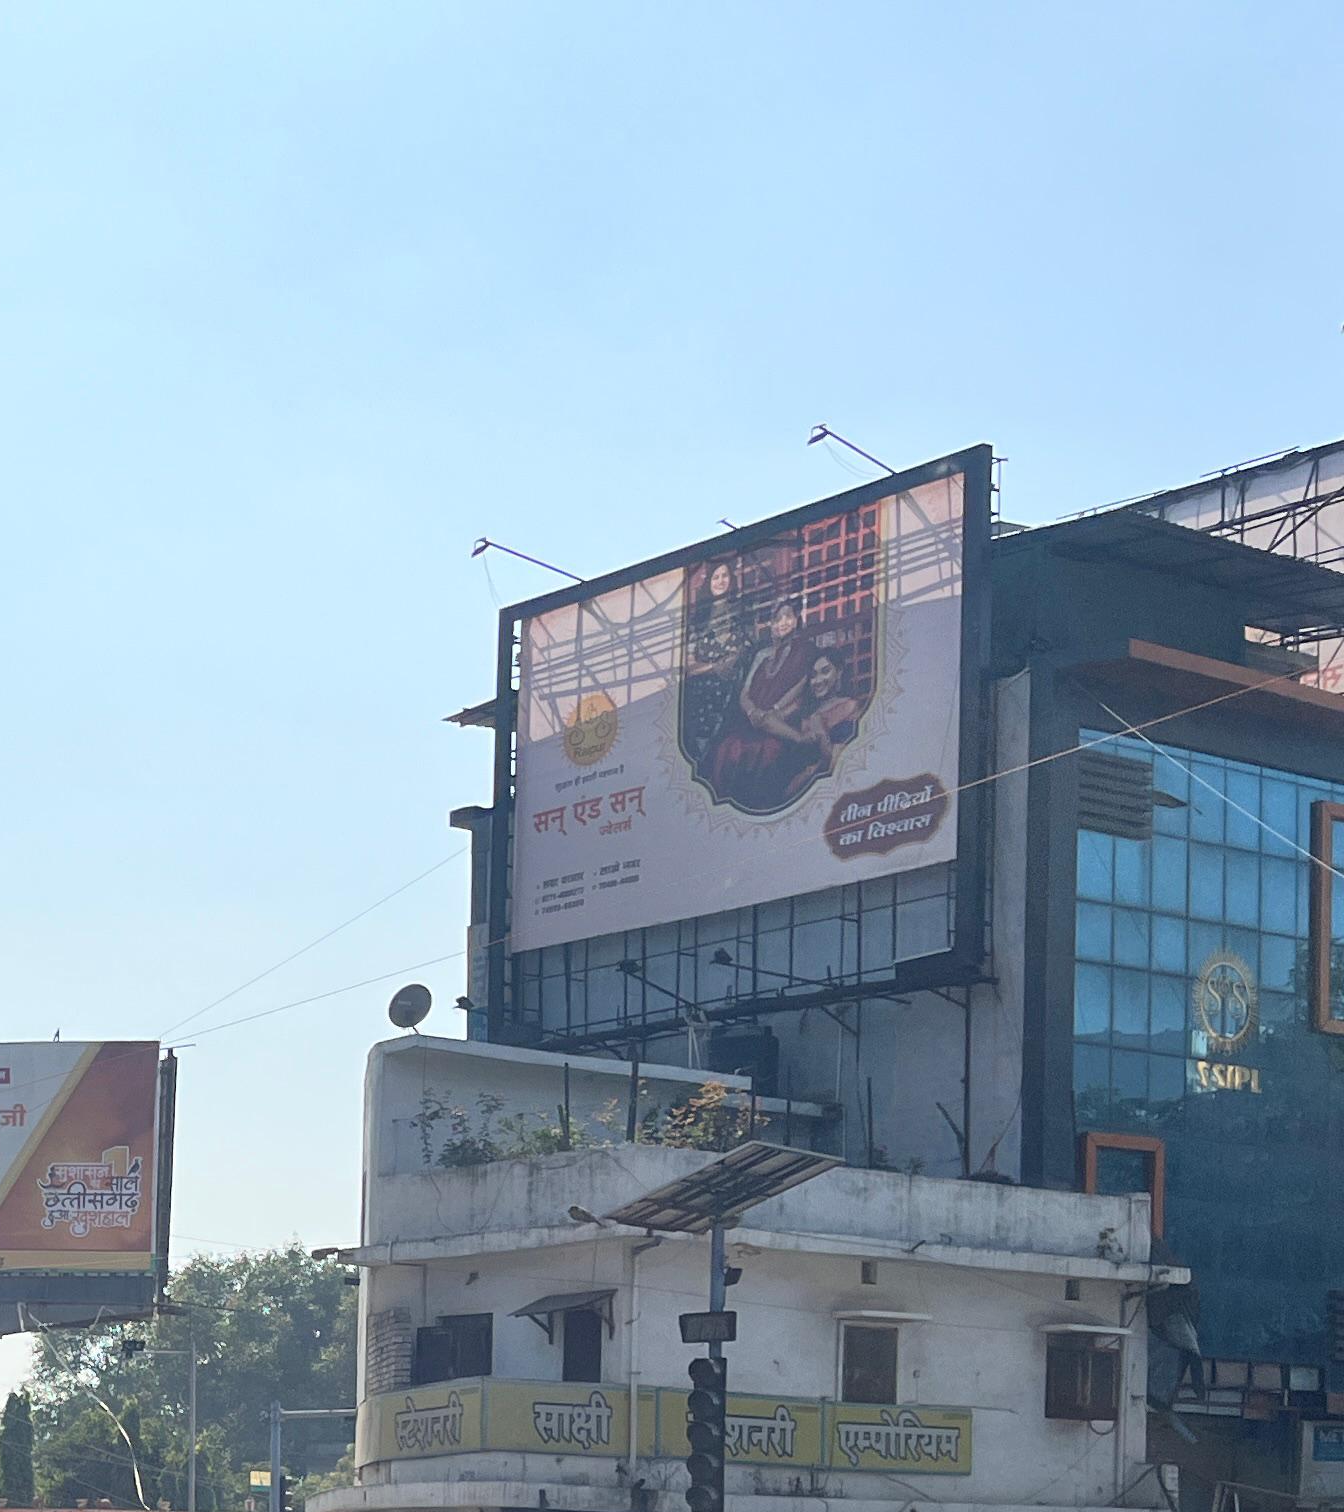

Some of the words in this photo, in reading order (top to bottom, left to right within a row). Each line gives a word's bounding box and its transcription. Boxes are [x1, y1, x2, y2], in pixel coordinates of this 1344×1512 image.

[533, 806, 568, 836] सन्
[572, 794, 603, 826] एंड
[609, 786, 646, 817] सन्
[840, 803, 874, 823] तीन
[840, 829, 865, 846] का
[867, 813, 933, 840] विश्वास
[1197, 1060, 1262, 1093] SSIPL
[44, 1181, 140, 1213] छत्तीसगढ़
[395, 1391, 463, 1450] स्टेशनरी
[533, 1391, 612, 1449] साक्षी
[725, 1404, 796, 1457] शनरी
